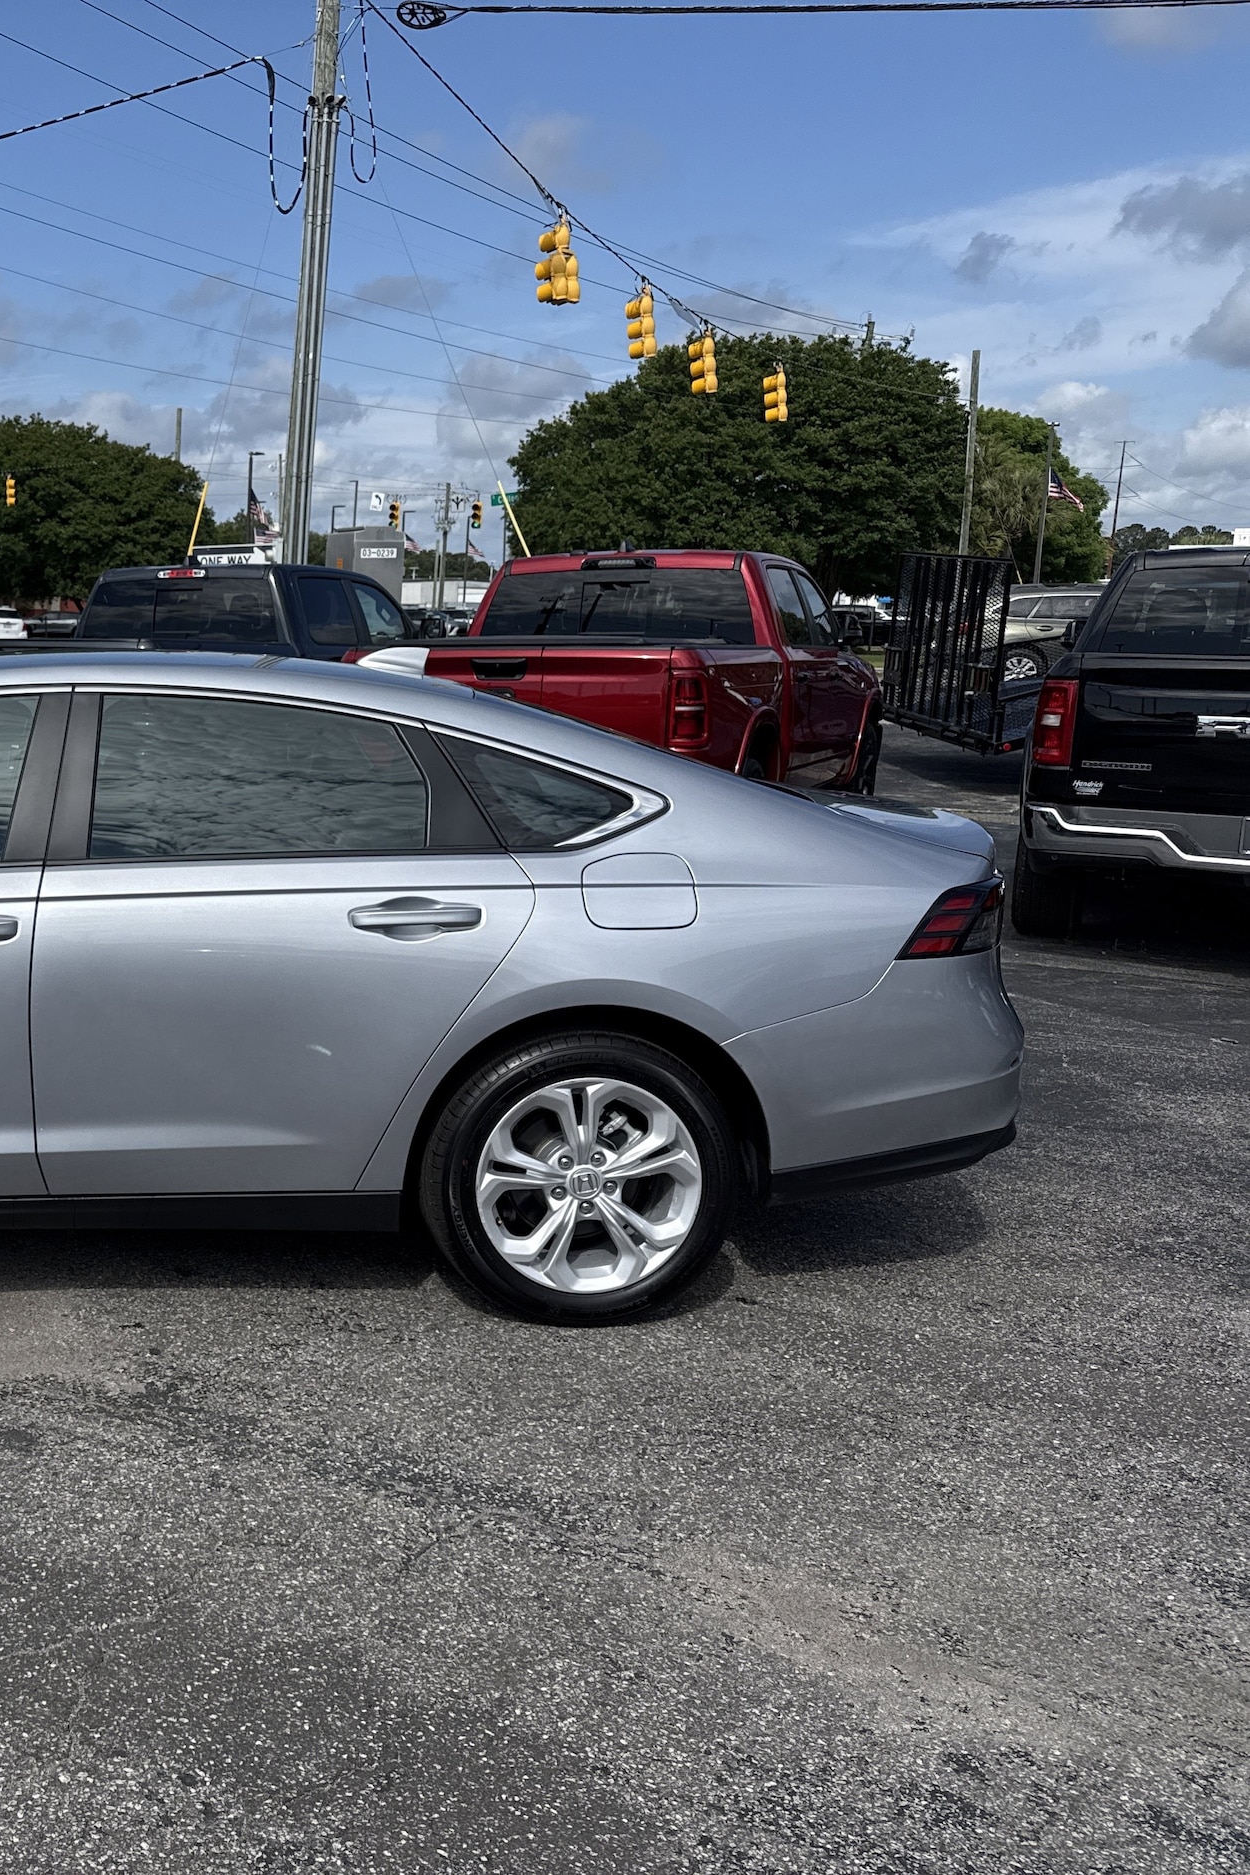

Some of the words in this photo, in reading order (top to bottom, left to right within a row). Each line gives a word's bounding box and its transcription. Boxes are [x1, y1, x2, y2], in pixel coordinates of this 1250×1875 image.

[362, 549, 394, 557] 03-0239
[201, 556, 222, 565] ONE
[228, 555, 251, 564] WAY
[1072, 780, 1104, 788] Hendrick
[450, 1204, 477, 1255] ENERGY
